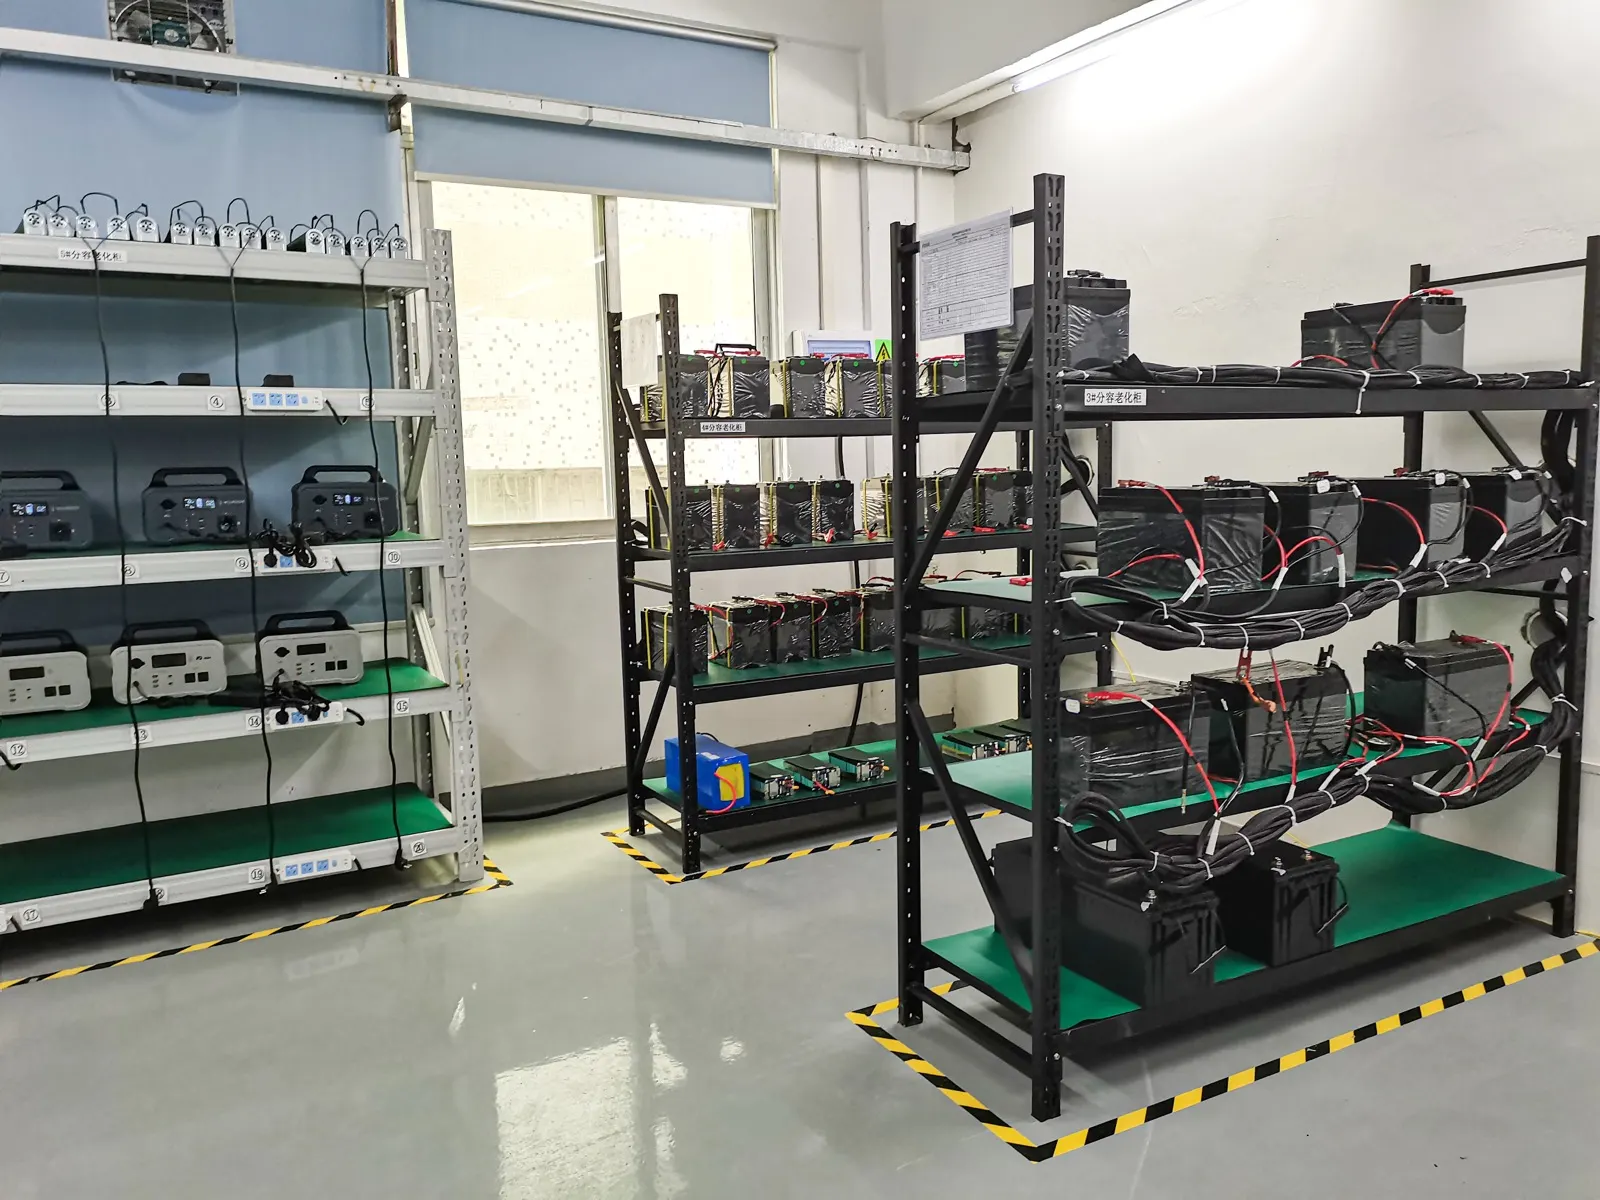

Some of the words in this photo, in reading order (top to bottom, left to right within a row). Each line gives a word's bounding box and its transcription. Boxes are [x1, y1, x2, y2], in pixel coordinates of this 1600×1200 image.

[1086, 391, 1142, 404] 3#分容老化柜
[389, 551, 400, 563] 10
[11, 744, 25, 756] 12
